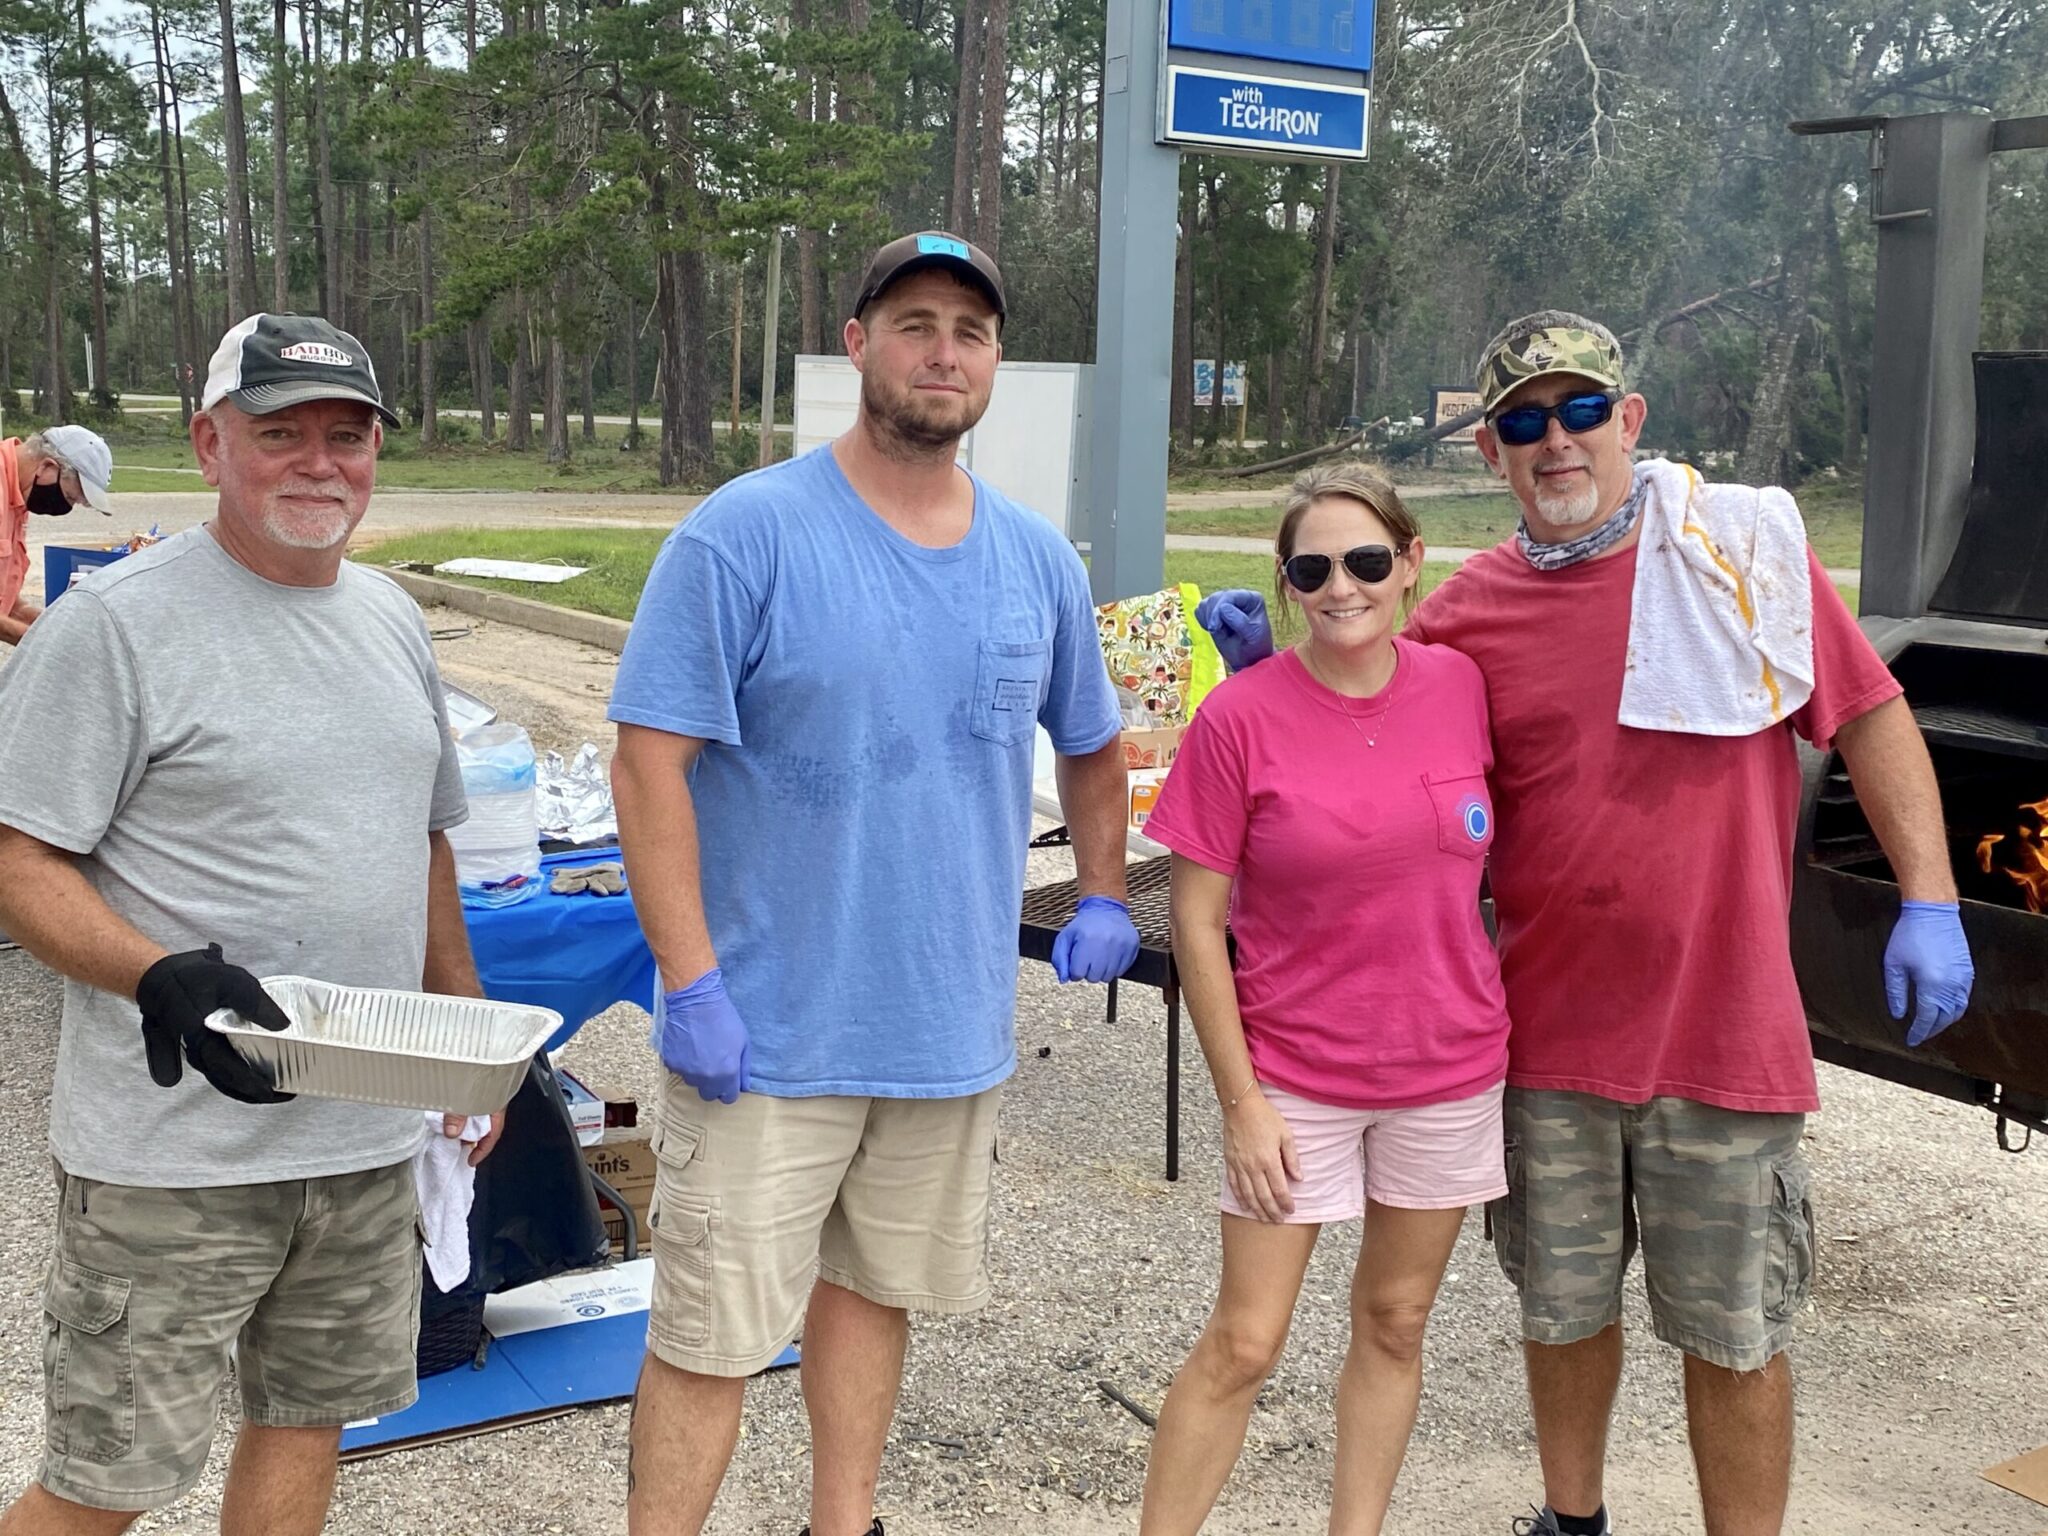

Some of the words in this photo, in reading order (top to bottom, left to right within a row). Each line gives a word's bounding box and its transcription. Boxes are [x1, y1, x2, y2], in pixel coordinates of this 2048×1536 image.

[1232, 85, 1263, 104] with
[1219, 97, 1320, 139] TECHRON
[283, 346, 319, 356] BAD
[323, 347, 352, 363] BOY
[588, 1154, 630, 1175] unt's
